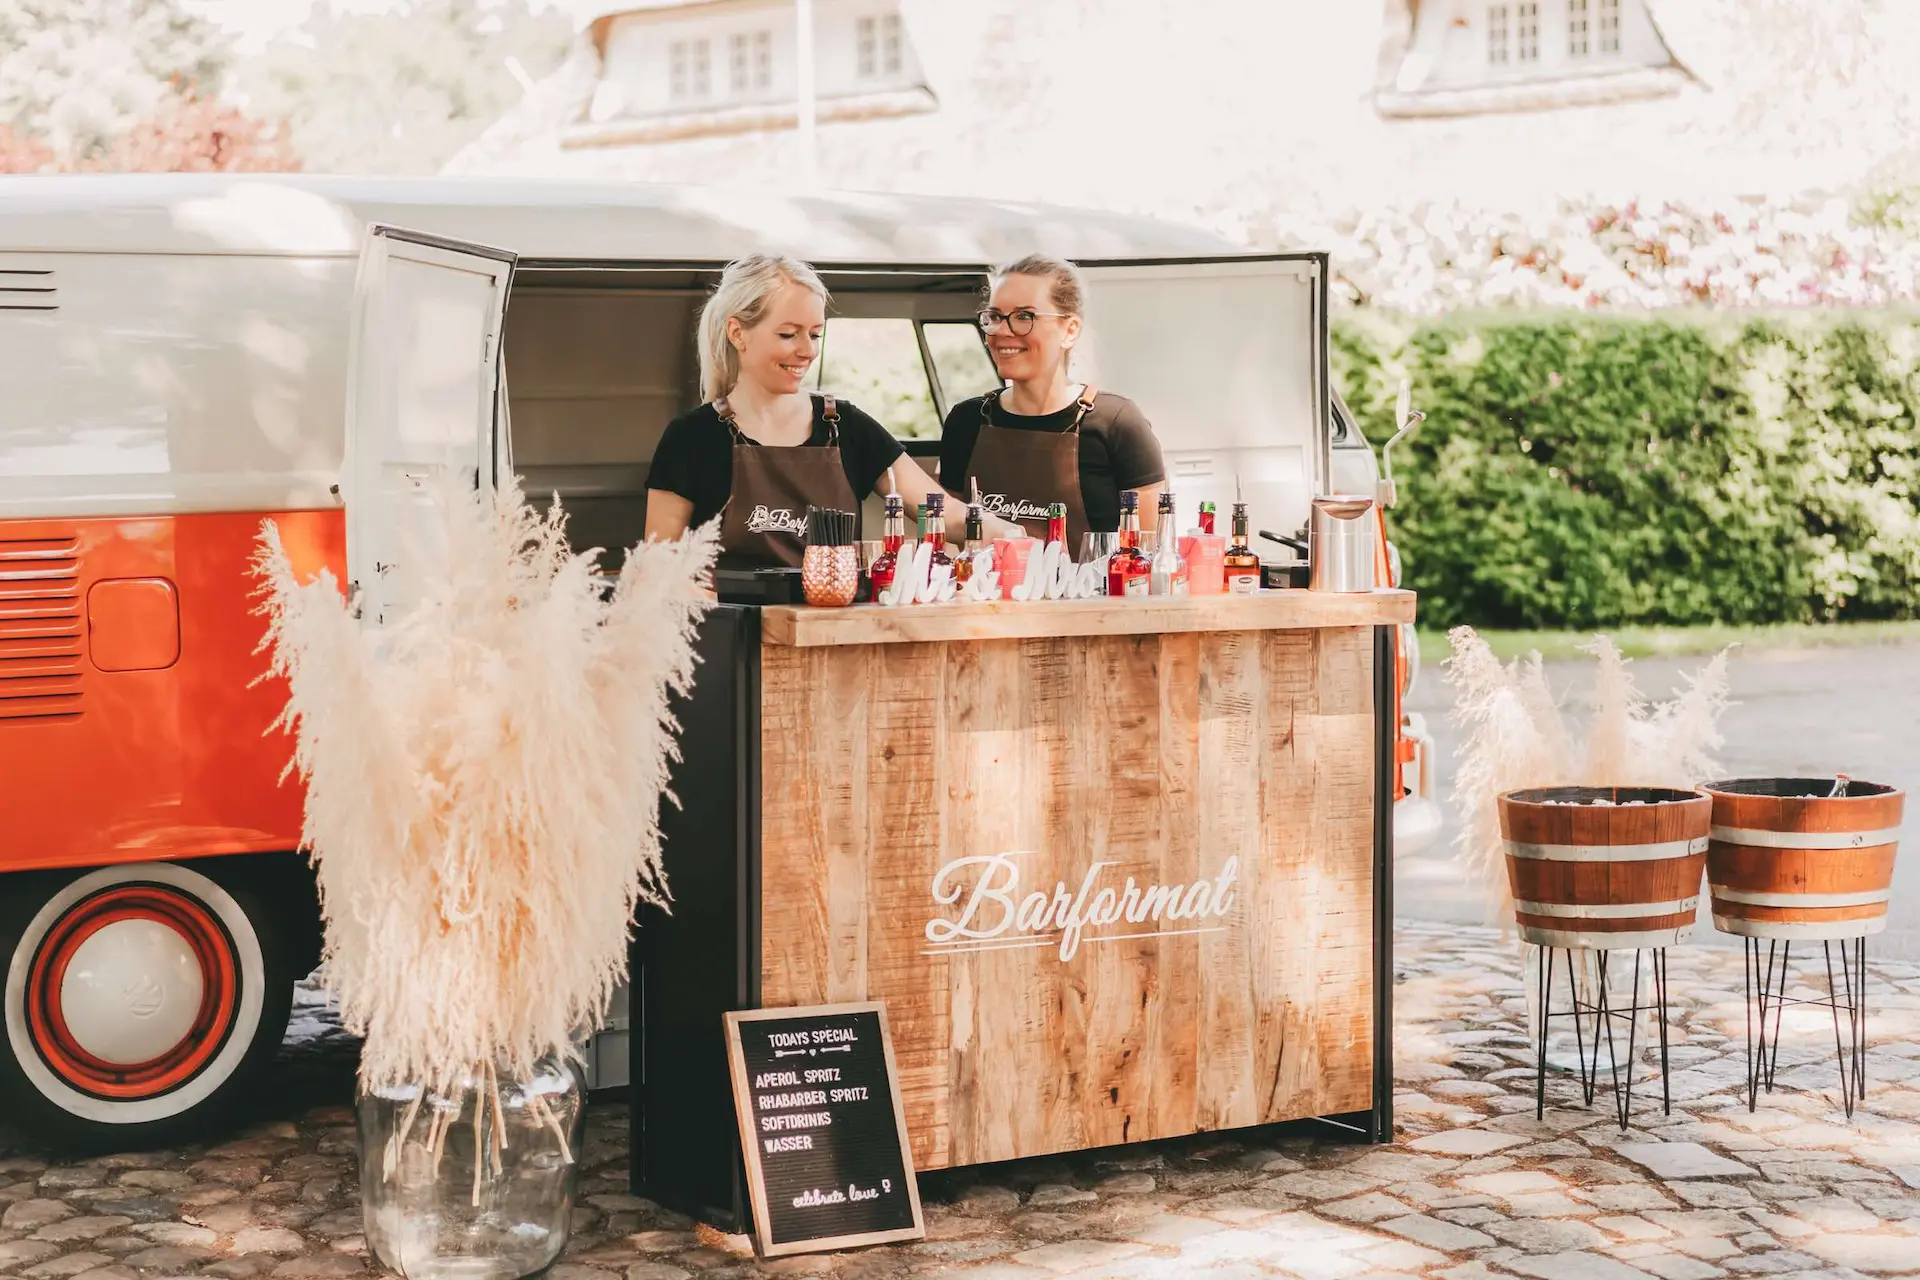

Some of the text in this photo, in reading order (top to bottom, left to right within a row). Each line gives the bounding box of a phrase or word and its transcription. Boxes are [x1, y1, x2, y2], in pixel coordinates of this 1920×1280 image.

[924, 850, 1239, 963] Barformat
[767, 1027, 859, 1048] TODAYS SPECIAL
[755, 1068, 842, 1089] APEROL SPRITZ
[758, 1086, 869, 1111] RHABARBER SPRITZ
[760, 1111, 832, 1132] SOFTDRINKS
[764, 1135, 813, 1154] WASSER
[792, 1183, 880, 1209] celebrate love
